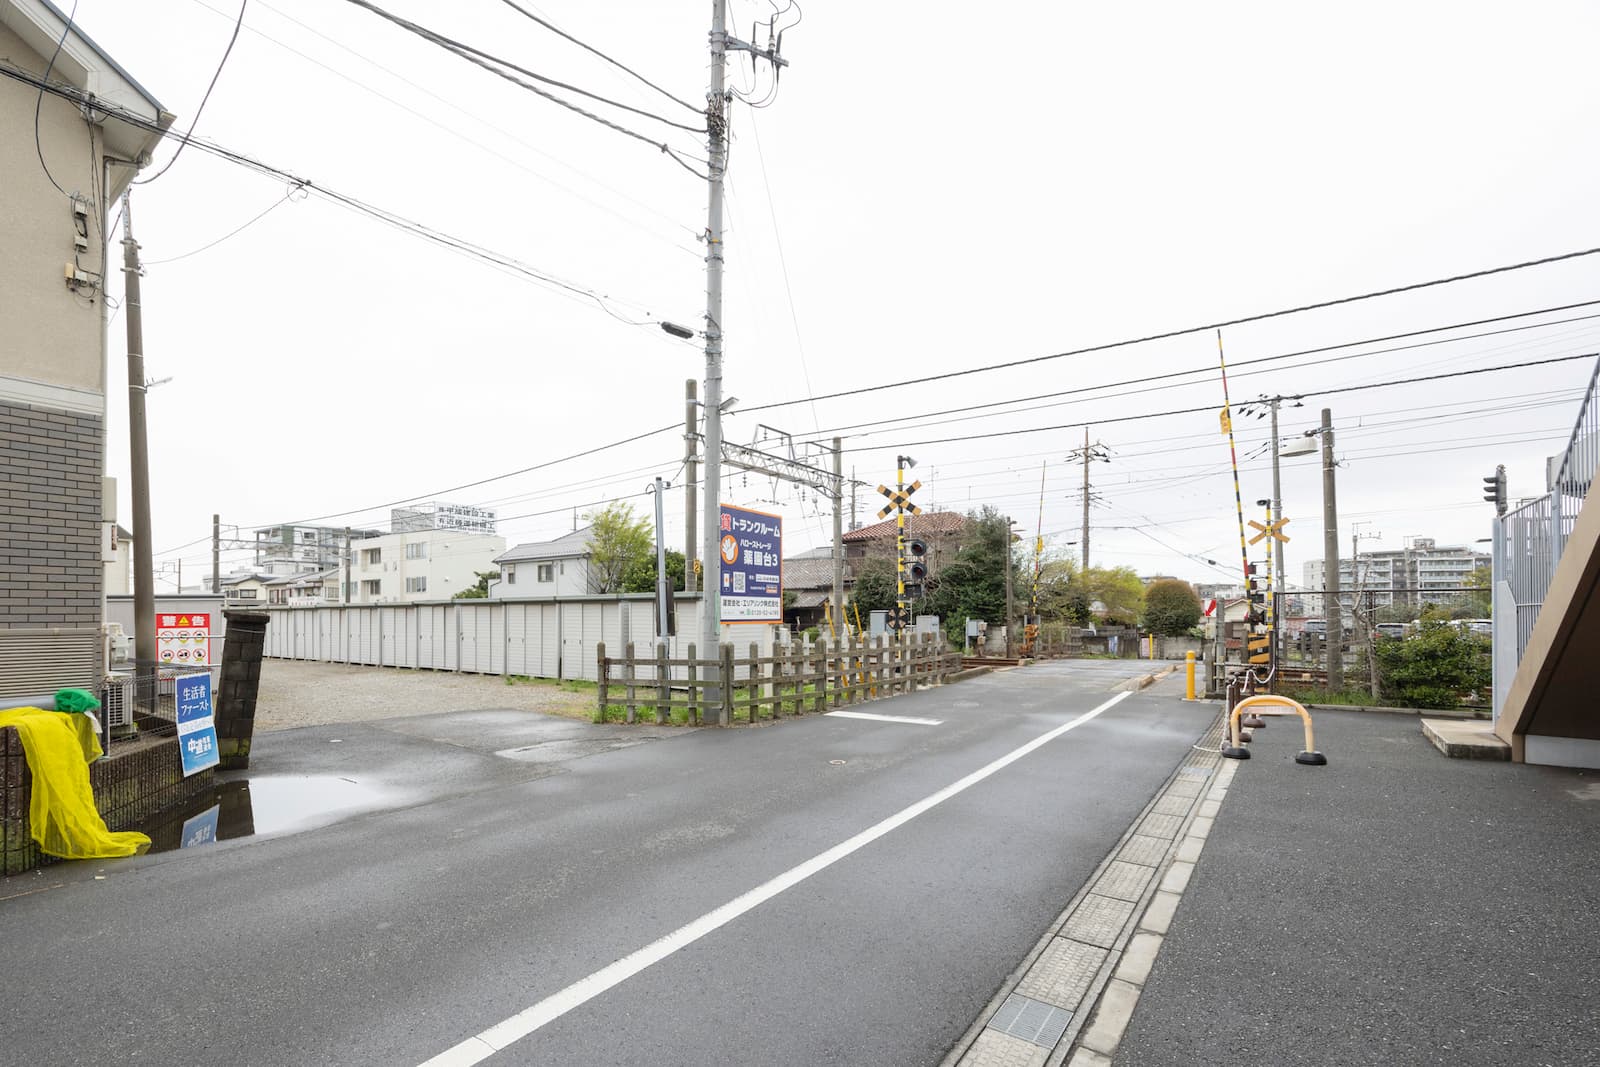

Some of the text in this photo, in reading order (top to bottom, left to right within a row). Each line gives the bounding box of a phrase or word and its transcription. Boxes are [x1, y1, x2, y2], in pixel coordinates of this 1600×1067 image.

[740, 538, 772, 550] ハローストレージ
[743, 549, 778, 567] 薬園台3
[183, 684, 206, 702] 生活者
[181, 699, 209, 716] ファースト
